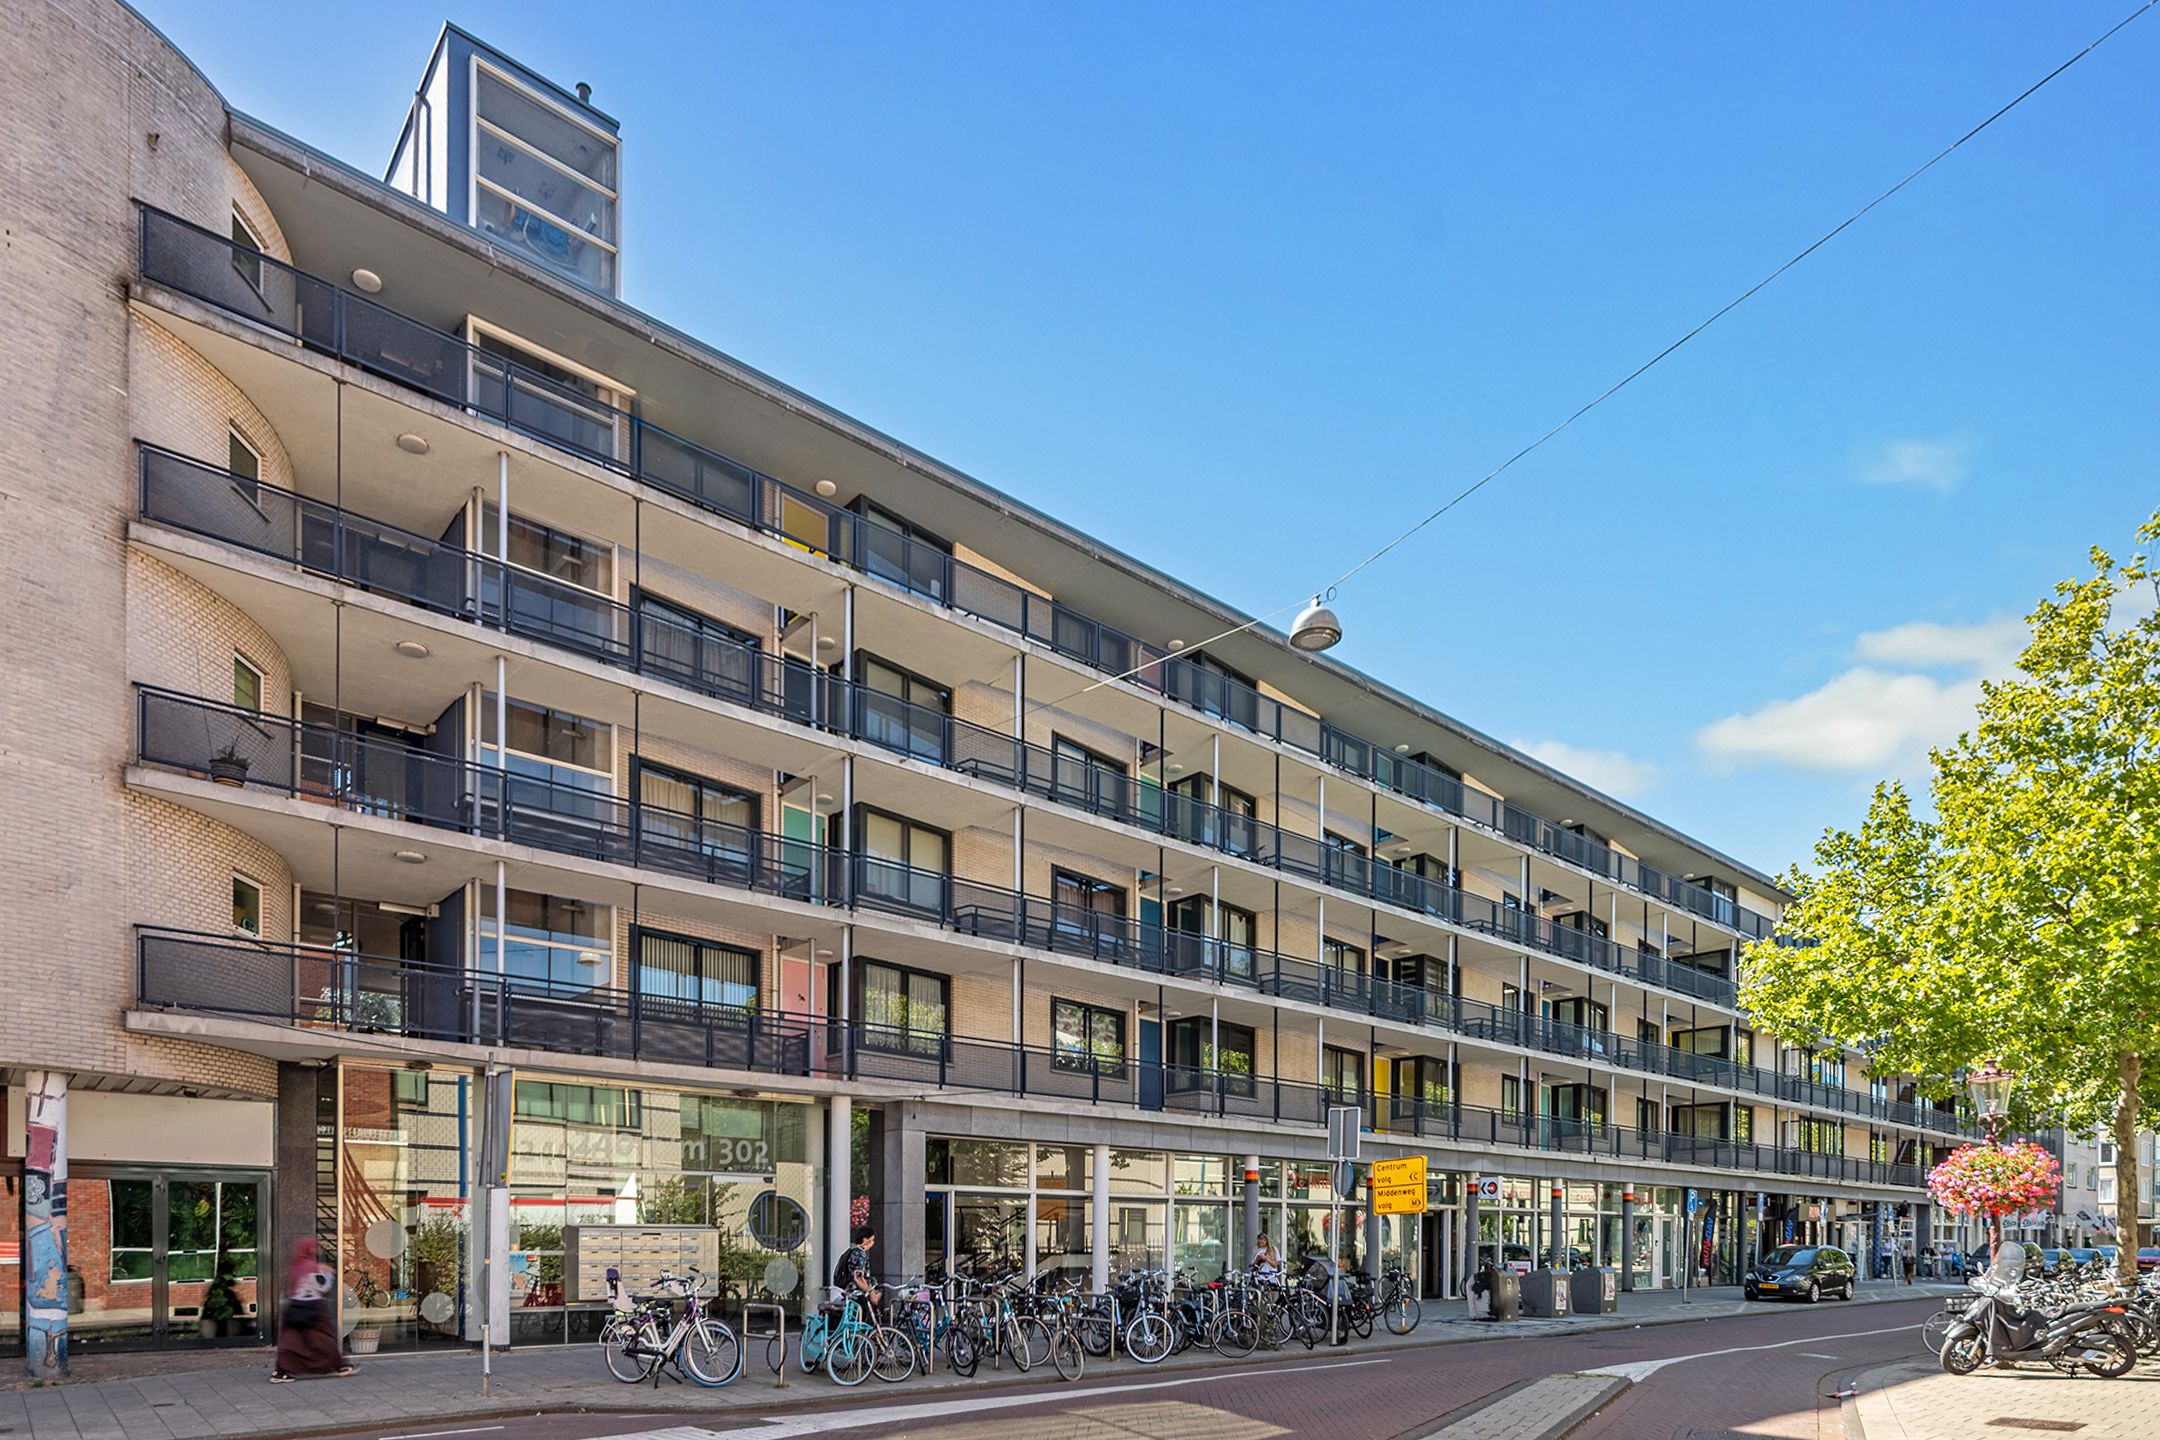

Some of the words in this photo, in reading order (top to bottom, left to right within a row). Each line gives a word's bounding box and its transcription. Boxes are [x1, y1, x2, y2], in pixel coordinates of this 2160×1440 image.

[719, 1138, 769, 1165] 302
[1376, 1163, 1408, 1172] Centrum
[1377, 1176, 1392, 1184] volg
[1377, 1188, 1416, 1197] Middenweg
[1378, 1202, 1392, 1210] volg
